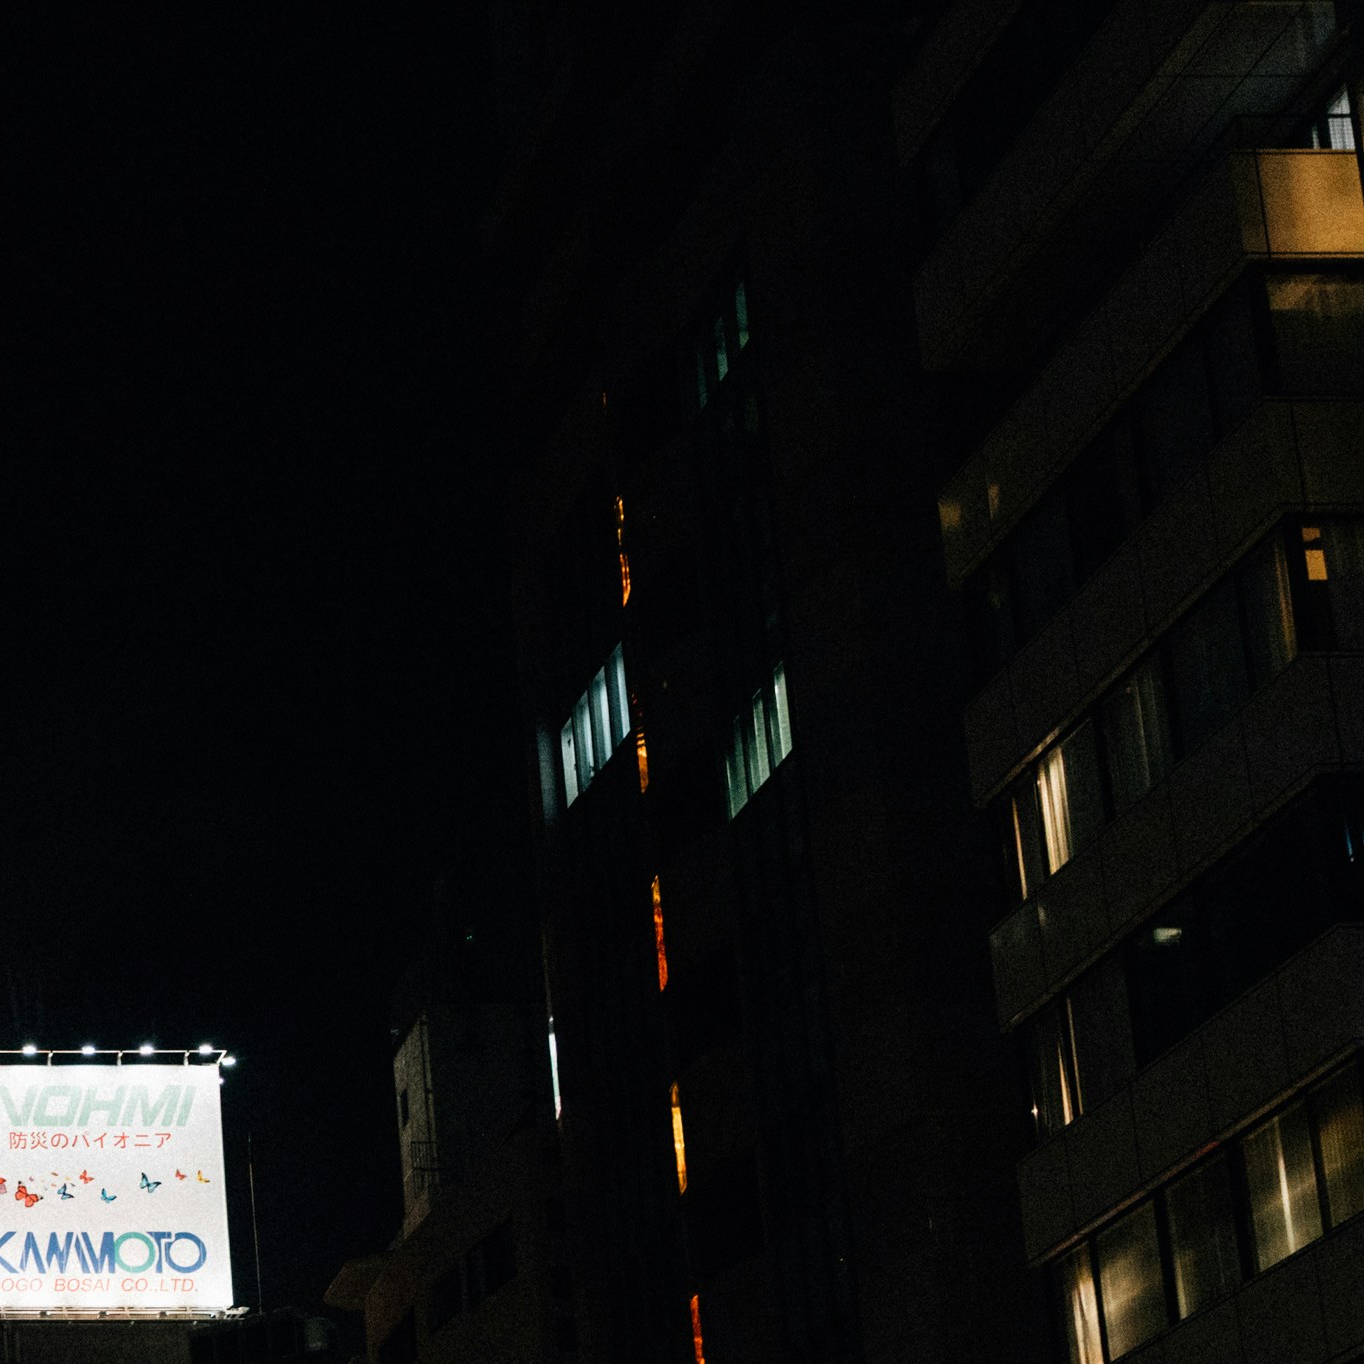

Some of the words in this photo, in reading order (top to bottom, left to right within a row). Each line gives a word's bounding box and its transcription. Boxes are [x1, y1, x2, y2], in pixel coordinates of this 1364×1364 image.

[9, 1131, 172, 1149] 防災のパイオニア
[54, 1278, 110, 1292] BOSAI
